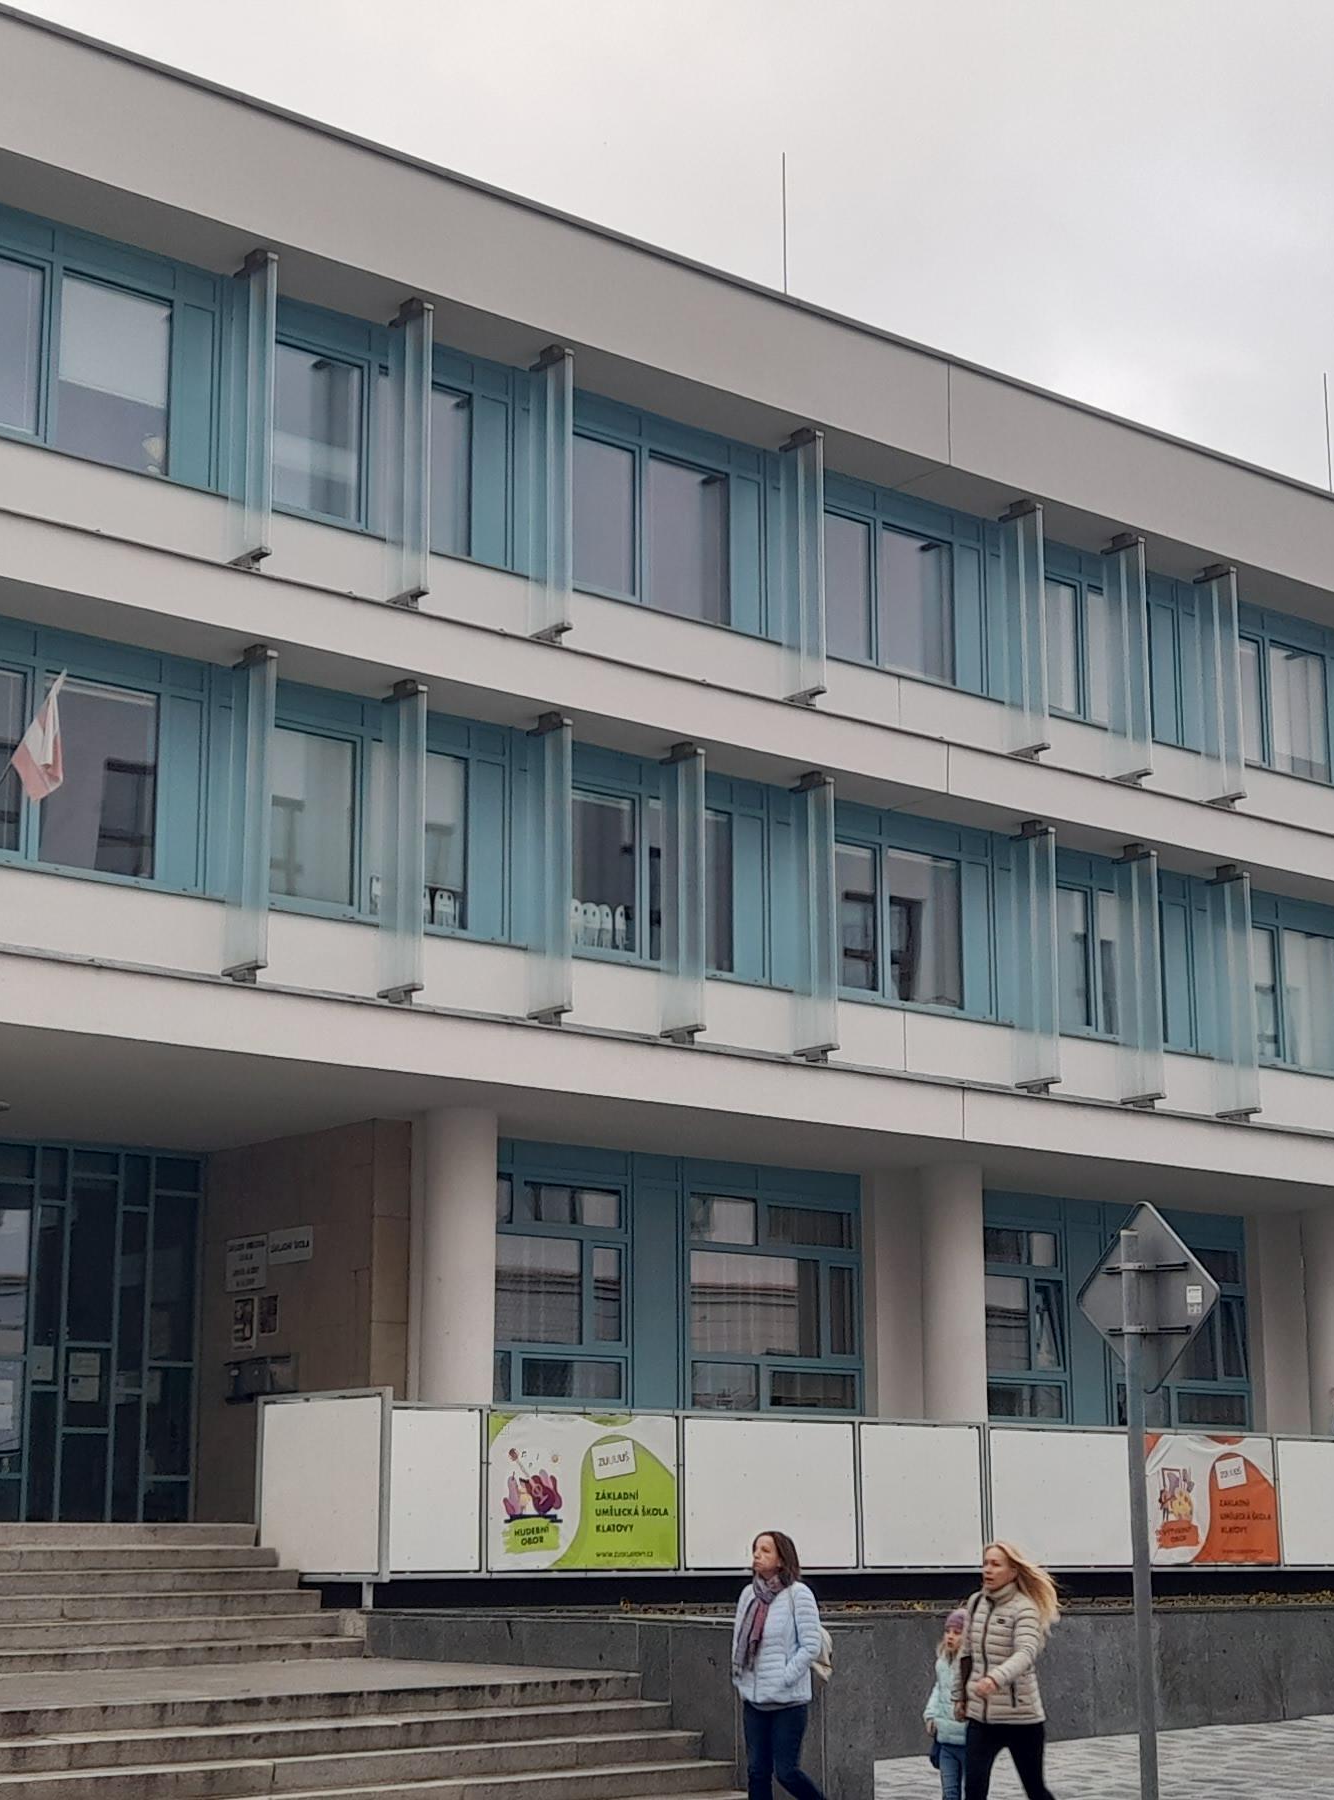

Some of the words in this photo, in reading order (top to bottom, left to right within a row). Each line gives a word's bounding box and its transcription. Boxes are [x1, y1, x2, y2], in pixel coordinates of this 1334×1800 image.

[595, 1489, 639, 1500] ZÁKLADNÍ
[595, 1505, 639, 1517] UMĚLECKÁ
[641, 1504, 669, 1517] ŠKOLA
[514, 1524, 550, 1537] HUDEBNÍ
[595, 1523, 634, 1533] KLATOVY
[521, 1535, 544, 1546] OBOR
